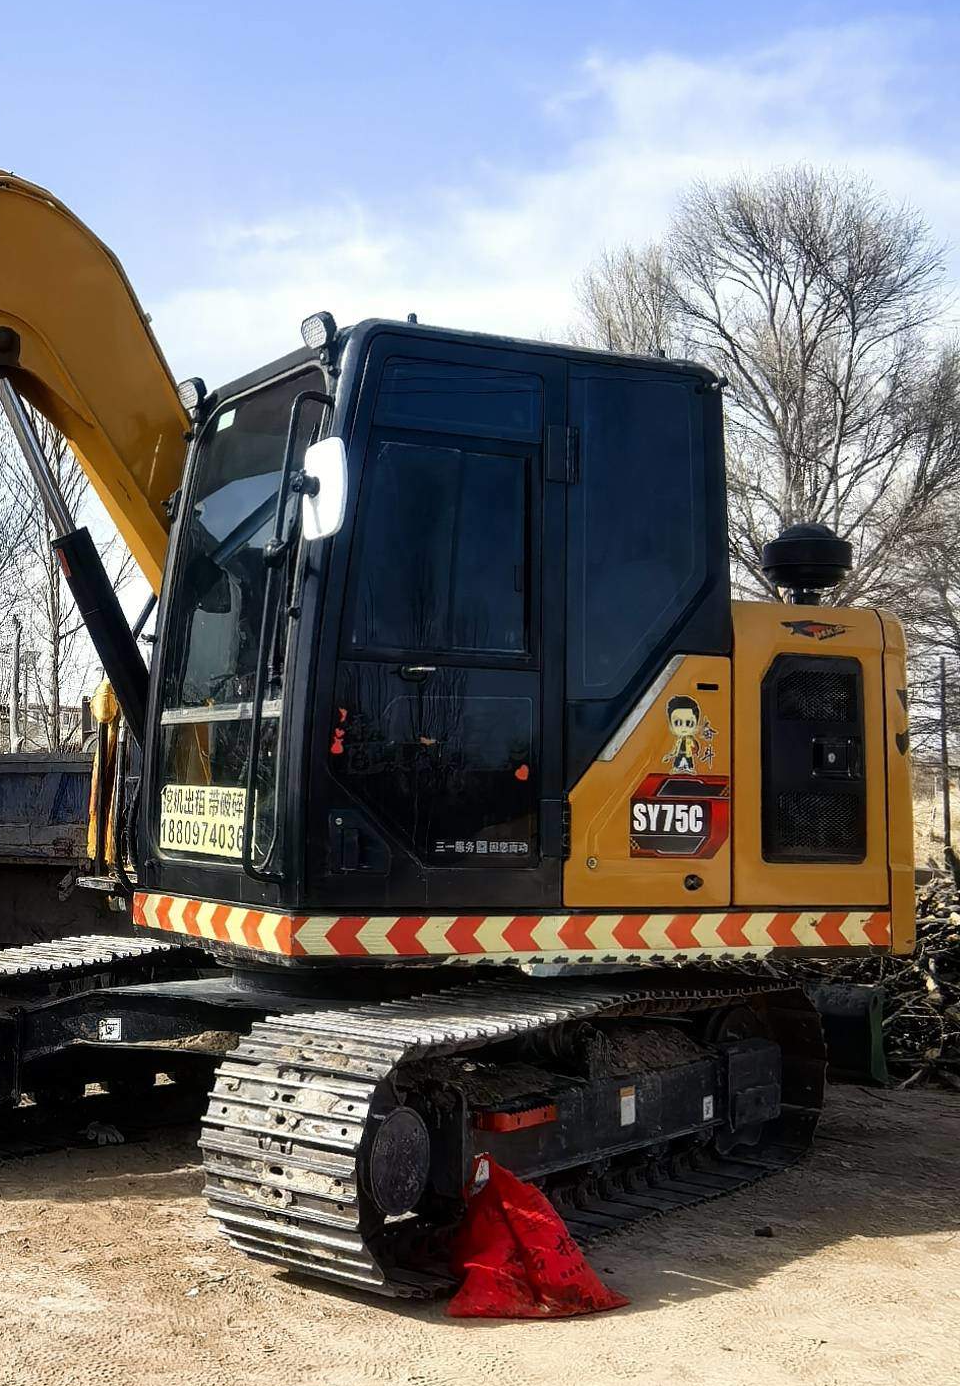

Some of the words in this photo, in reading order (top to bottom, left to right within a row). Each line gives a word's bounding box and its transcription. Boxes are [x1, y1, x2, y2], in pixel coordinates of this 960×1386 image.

[161, 788, 206, 816] 挖机出租
[633, 803, 703, 833] SY75C
[161, 818, 244, 853] 1880974036
[434, 840, 475, 853] 三一服务
